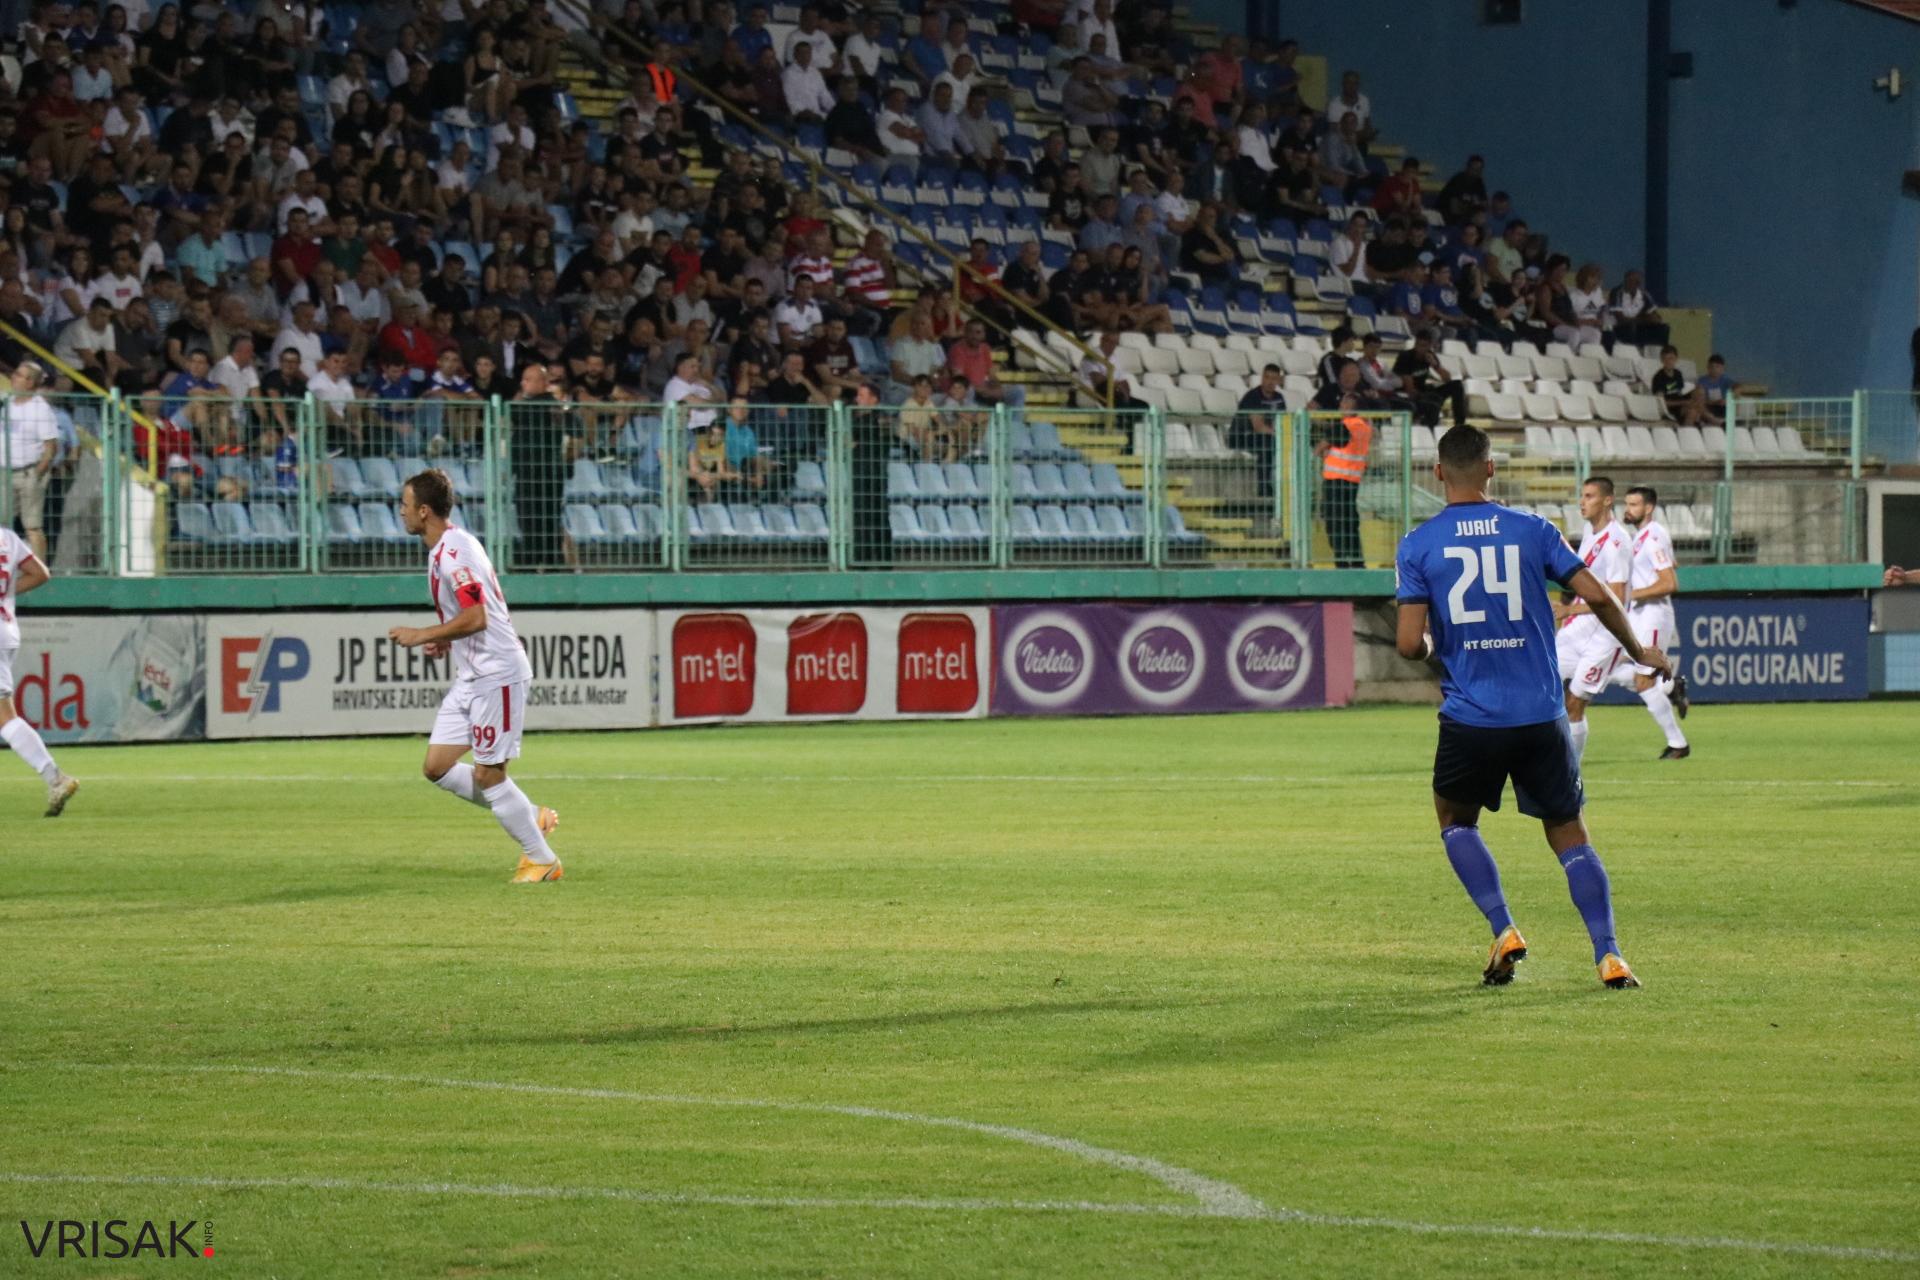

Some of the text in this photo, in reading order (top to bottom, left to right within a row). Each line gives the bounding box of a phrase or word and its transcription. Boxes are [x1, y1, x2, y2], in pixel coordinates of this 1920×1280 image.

[1455, 515, 1500, 537] JURIĆ
[1443, 544, 1523, 625] 24
[334, 637, 365, 684] JP
[904, 642, 968, 681] m:tel
[1022, 642, 1075, 673] Violeta
[1136, 642, 1187, 673] Violeta
[1244, 642, 1296, 673] Violeta
[1463, 640, 1479, 651] HT
[681, 642, 747, 683] m:tel
[794, 642, 859, 682] m:tel
[1692, 652, 1845, 686] OSIGURANJE
[14, 652, 90, 730] da
[333, 688, 396, 710] HRVATSKE
[586, 684, 628, 705] Mostar
[472, 725, 496, 748] 99
